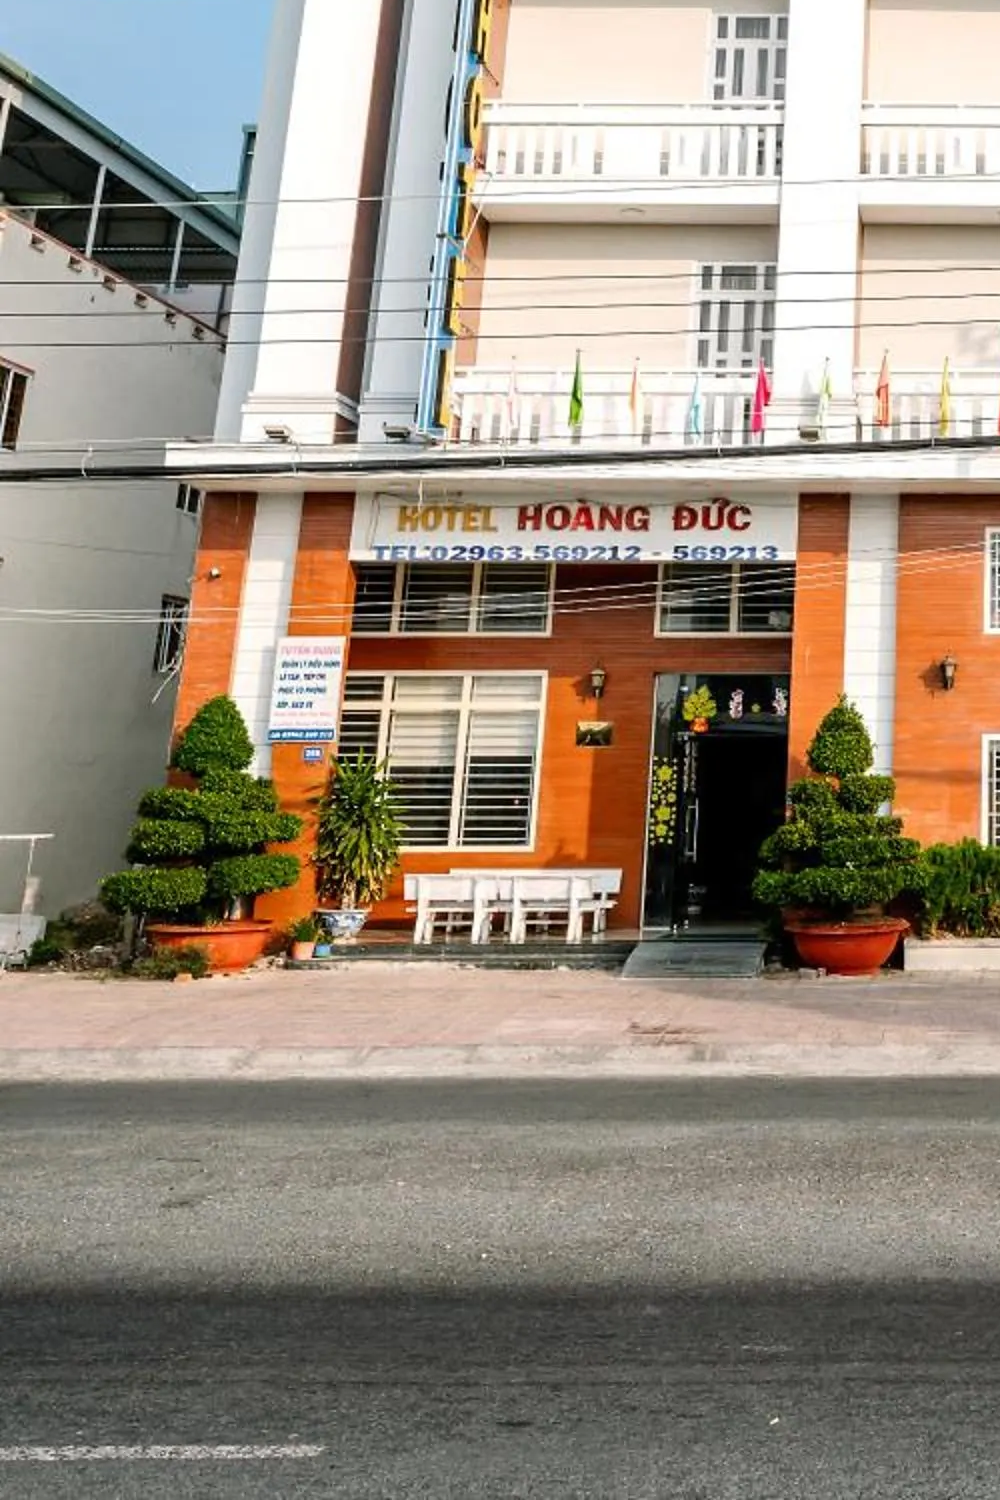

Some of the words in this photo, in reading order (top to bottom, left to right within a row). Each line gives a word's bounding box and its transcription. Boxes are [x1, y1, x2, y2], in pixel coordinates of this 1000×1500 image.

[397, 504, 498, 532] HOTEL
[517, 498, 649, 532] HOÀNG
[672, 496, 752, 532] ĐỨC
[672, 544, 779, 561] 569213
